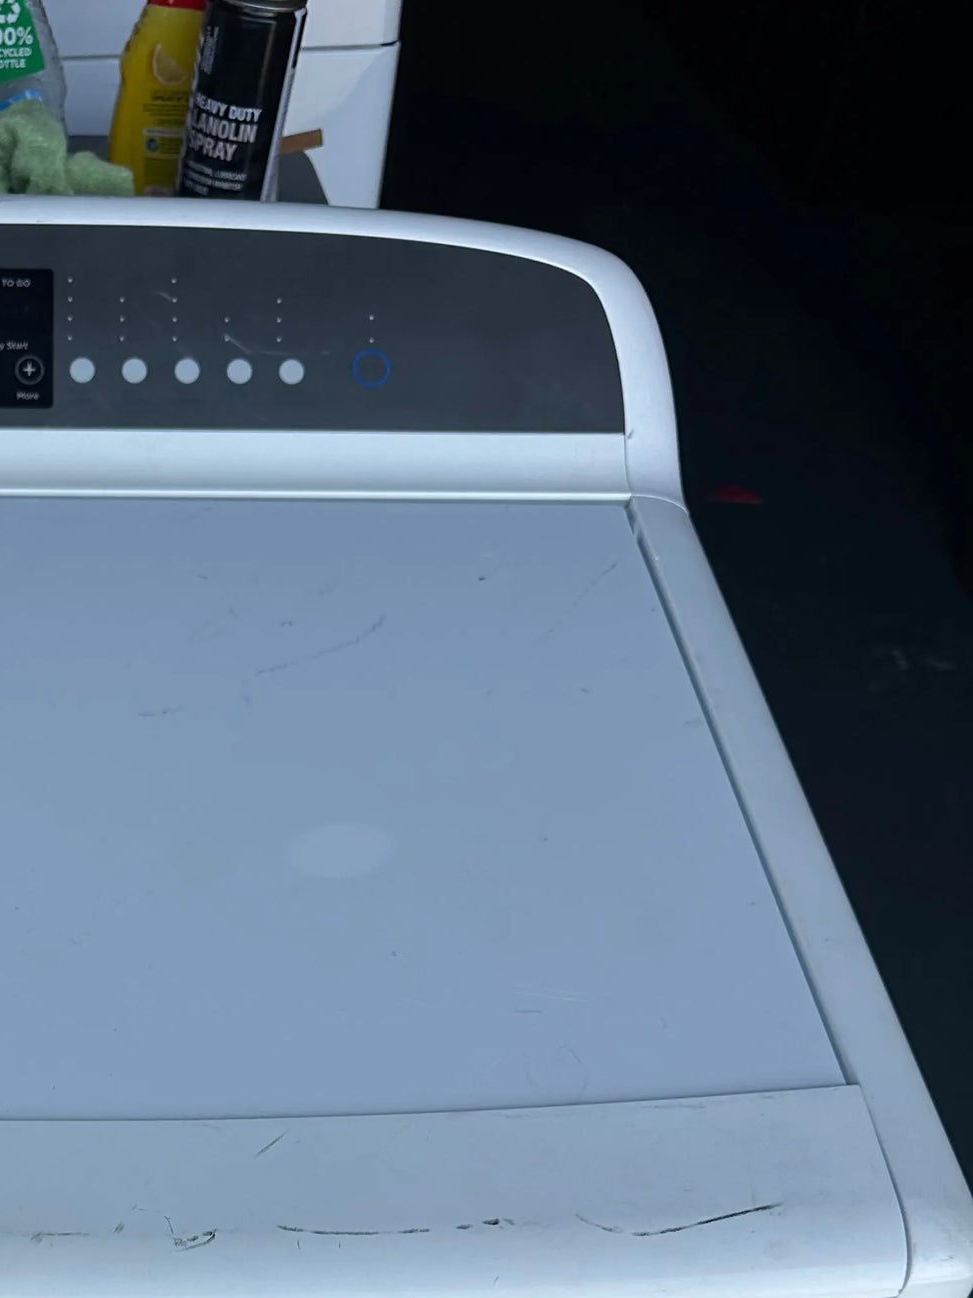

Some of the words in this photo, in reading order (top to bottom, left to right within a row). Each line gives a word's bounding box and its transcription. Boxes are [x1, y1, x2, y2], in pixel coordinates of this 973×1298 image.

[228, 105, 263, 122] DUTY
[191, 108, 258, 143] LANOLIN
[1, 278, 15, 287] TO
[16, 278, 31, 288] GO
[6, 341, 28, 351] Start
[16, 392, 39, 401] More
